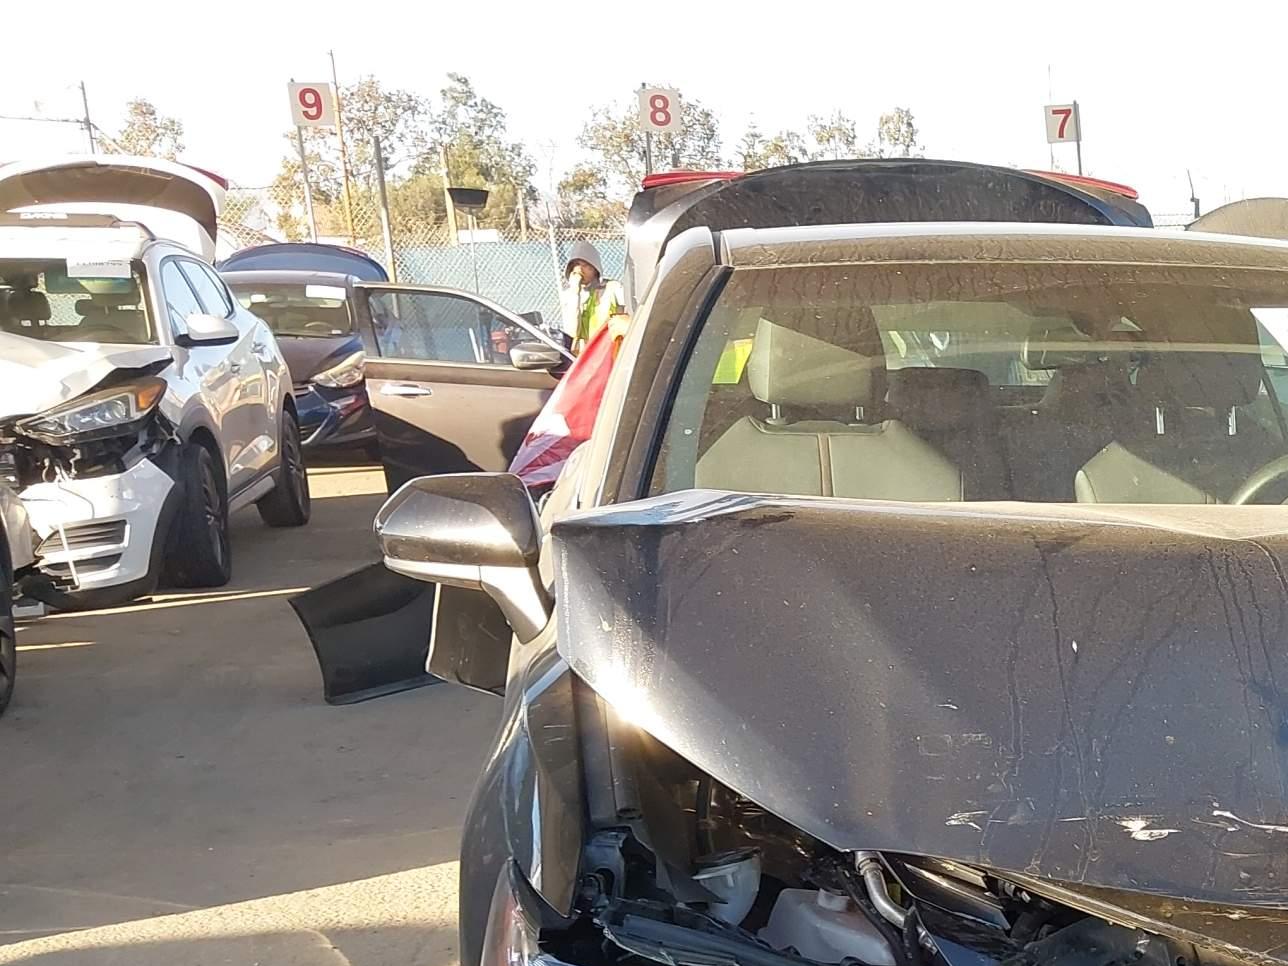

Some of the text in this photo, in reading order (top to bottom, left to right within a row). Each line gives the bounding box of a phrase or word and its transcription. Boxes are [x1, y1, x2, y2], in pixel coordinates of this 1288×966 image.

[298, 87, 323, 121] 9
[648, 94, 672, 126] 8
[1051, 108, 1073, 138] 7
